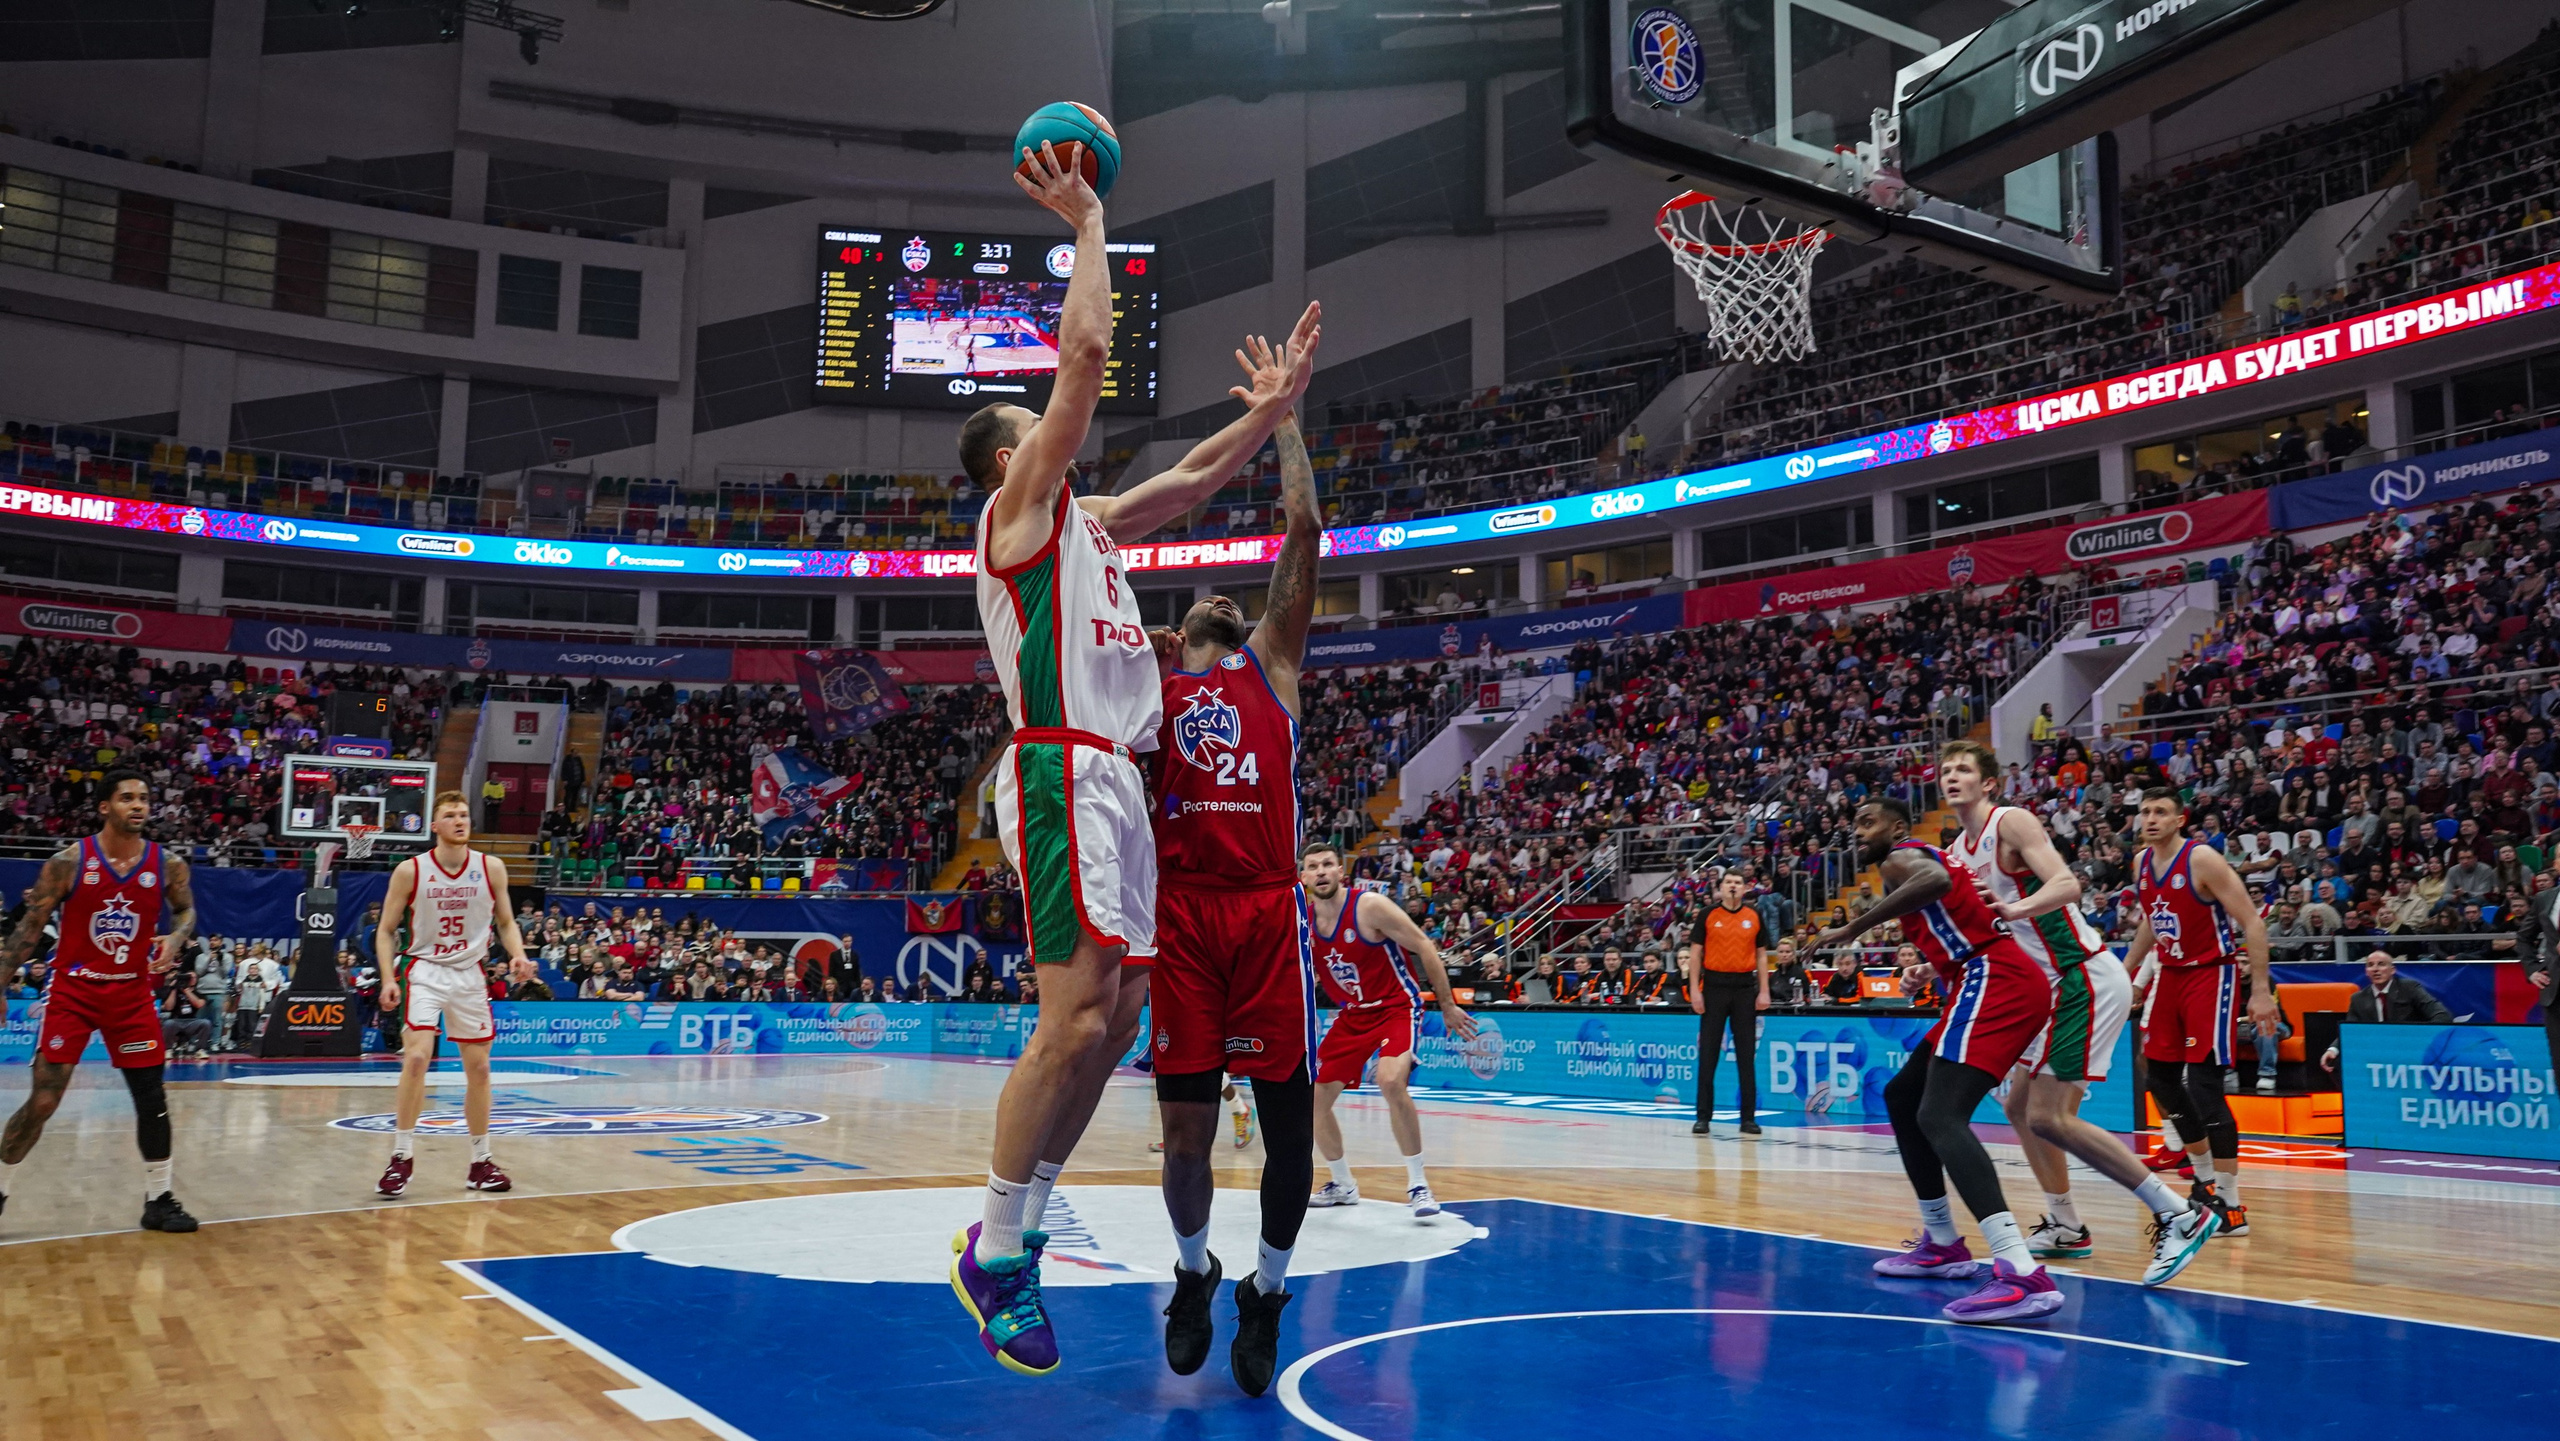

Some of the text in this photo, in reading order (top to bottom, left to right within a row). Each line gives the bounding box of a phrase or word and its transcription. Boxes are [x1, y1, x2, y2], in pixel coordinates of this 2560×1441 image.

[2116, 0, 2198, 42] НОРН
[825, 231, 881, 243] CSKA MOSCOW
[840, 247, 862, 264] 40
[954, 243, 964, 256] 2
[981, 243, 1012, 258] 3:37
[1125, 259, 1146, 275] 43
[2017, 280, 2527, 432] ЦСКА ВСЕГДА БУДЕТ ПЕРВЫМ!
[2434, 449, 2550, 484] НОРНИКЕЛЬ
[0, 487, 115, 521] ЕРВЫМ!
[1495, 512, 1538, 529] Winline
[404, 538, 453, 551] Winline
[2076, 526, 2156, 553] Winline
[1118, 540, 1263, 571] ДЕТ ПЕРВЫМ!
[1104, 565, 1118, 609] 6
[1777, 583, 1865, 606] Ростелеком
[32, 609, 108, 632] Winline
[1520, 615, 1613, 637] АЭРОФЛОТ
[2095, 607, 2115, 627] C2
[313, 637, 392, 653] НОРНИКЕЛЬ
[1310, 642, 1376, 657] НОРНИКЕЛЬ
[557, 653, 657, 667] АЭРОФЛОТ
[376, 698, 386, 712] 6
[1483, 694, 1497, 707] C1
[1185, 713, 1231, 738] CSKA
[337, 746, 372, 757] Winline
[1216, 752, 1259, 786] 24
[1182, 801, 1262, 814] Ростелеком
[426, 886, 478, 899] LOKOMOTIV
[97, 917, 133, 930] CSKA
[438, 916, 464, 937] 35
[114, 945, 130, 964] 6
[286, 1004, 345, 1025] GMS
[775, 1016, 921, 1030] ТИТУЛЬНЫЙ СПОНСОР
[550, 1018, 622, 1031] СПОНСОР
[679, 1014, 753, 1048] ВТБ
[535, 1033, 577, 1045] ЛИГИ
[580, 1033, 608, 1044] ВТБ
[787, 1030, 909, 1044] ЕДИНОЙ ЛИГИ ВТБ
[1225, 1041, 1250, 1050] inline
[1418, 1036, 1536, 1054] ИТУЛЬНЫЙ СПОНСОР
[1555, 1040, 1698, 1061] ТИТУЛЬНЫЙ СПОНСО
[1422, 1053, 1525, 1072] ЕДИНОЙ ЛИГИ ВТБ
[1567, 1058, 1693, 1081] ЕДИНОЙ ЛИГИ ВТБ
[1769, 1041, 1859, 1097] ВТБ
[2366, 1063, 2555, 1095] ТИТУЛЬНЫ
[2400, 1096, 2550, 1130] ЕДИНОЙ
